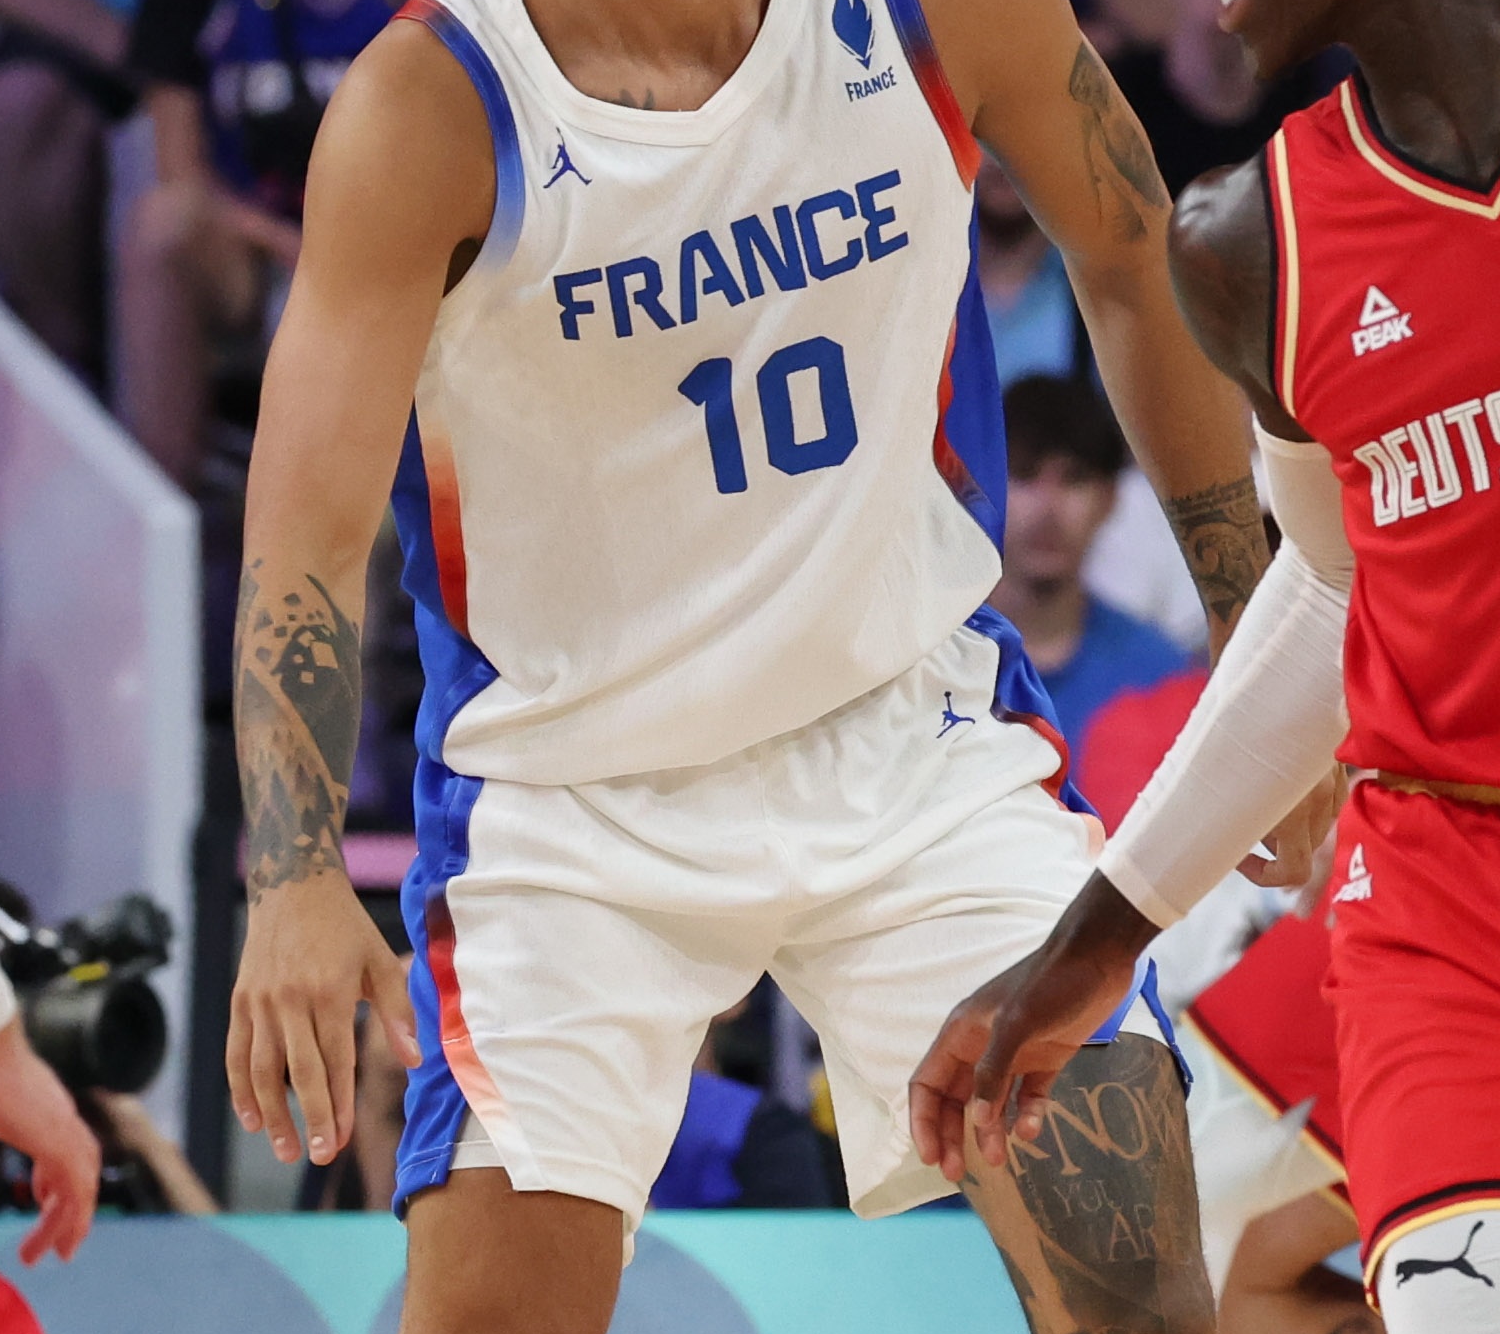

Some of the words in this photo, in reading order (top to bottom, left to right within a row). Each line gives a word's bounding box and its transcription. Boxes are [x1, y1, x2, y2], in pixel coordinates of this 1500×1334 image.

[844, 65, 897, 102] FRANCE
[553, 168, 910, 341] FRANCE
[1351, 312, 1414, 357] PEAK
[679, 336, 858, 495] 10
